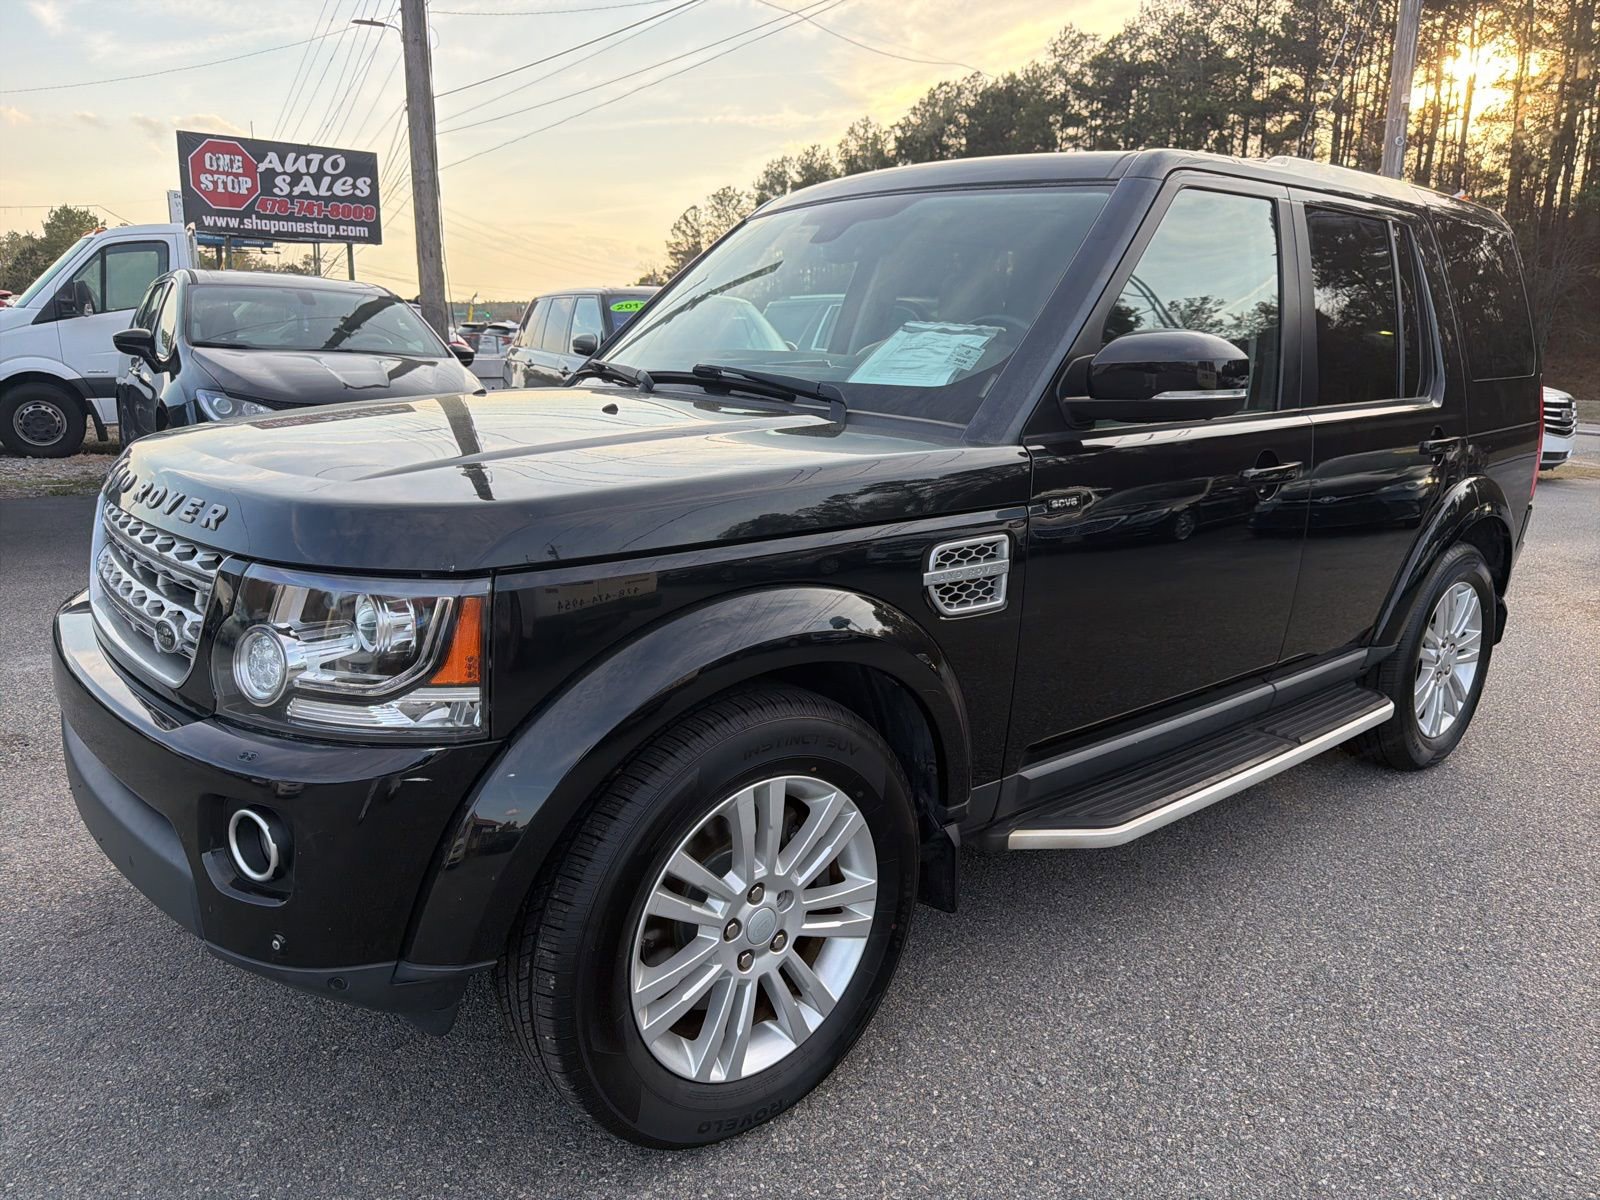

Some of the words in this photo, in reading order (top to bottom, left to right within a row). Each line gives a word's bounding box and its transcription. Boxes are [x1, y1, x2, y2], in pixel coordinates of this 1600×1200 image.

[204, 152, 244, 173] ONE
[257, 151, 346, 175] AUTO
[200, 173, 252, 195] STOP
[255, 196, 376, 222] 478-741-8009
[202, 214, 369, 238] www.shoponestop.com
[617, 302, 647, 311] 201
[132, 479, 229, 532] ROVER
[826, 735, 862, 756] SUV
[696, 1099, 784, 1134] ROVELO
